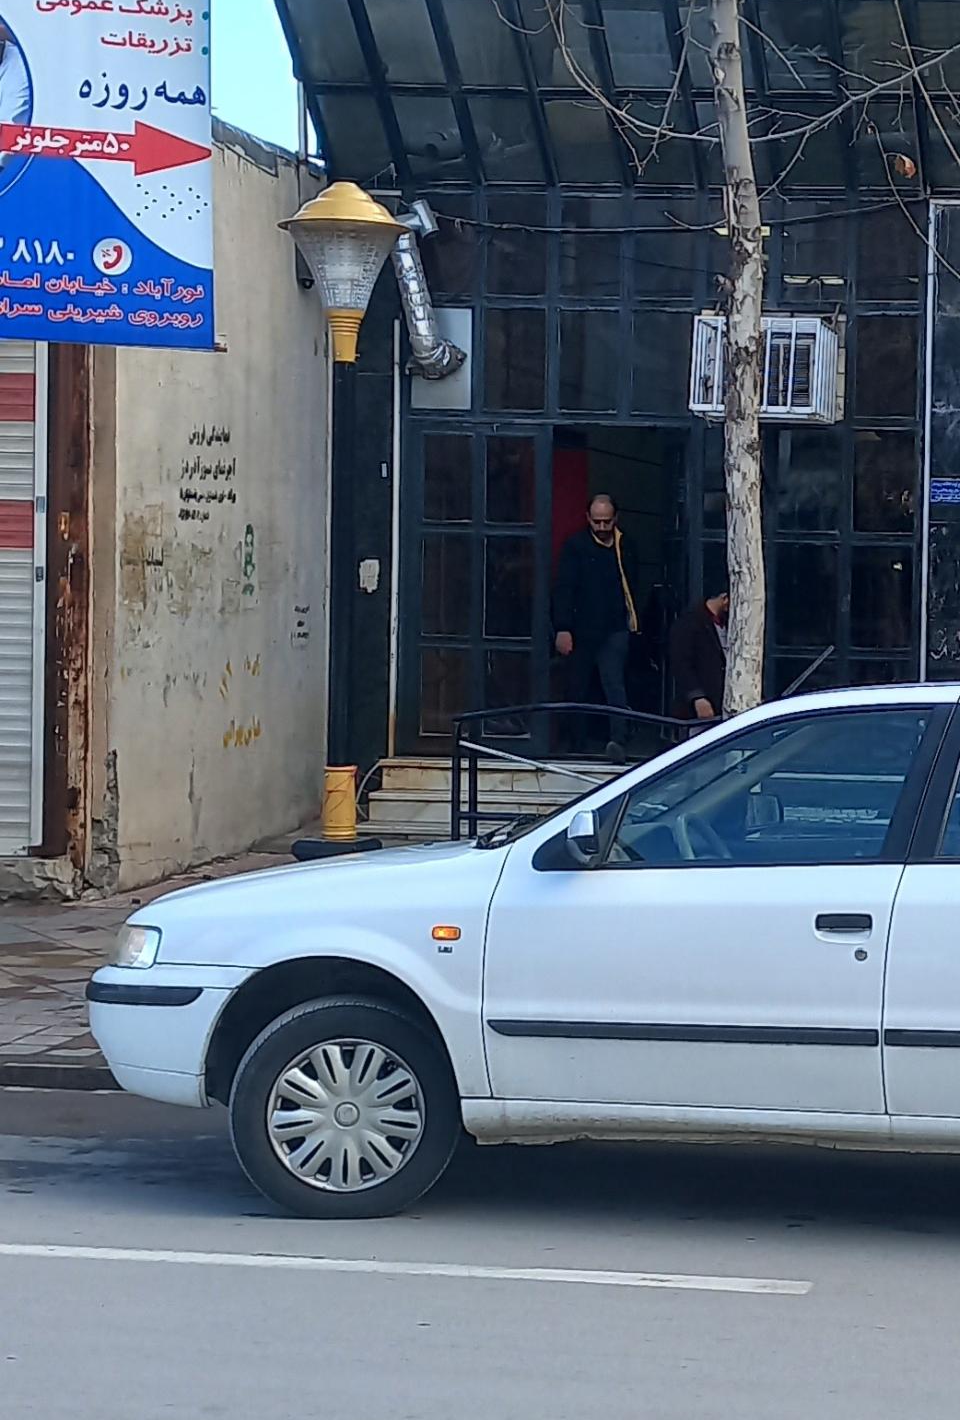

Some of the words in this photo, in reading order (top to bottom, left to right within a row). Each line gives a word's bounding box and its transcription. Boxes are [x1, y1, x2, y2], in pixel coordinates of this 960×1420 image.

[100, 30, 193, 57] تزریقات
[78, 72, 149, 111] روزه
[154, 79, 207, 107] همه
[10, 127, 70, 154] جلوتر
[45, 275, 118, 297] خیابان
[133, 278, 205, 304] نورآباد
[48, 303, 124, 325] شیرینی
[128, 308, 204, 329] روبروی
